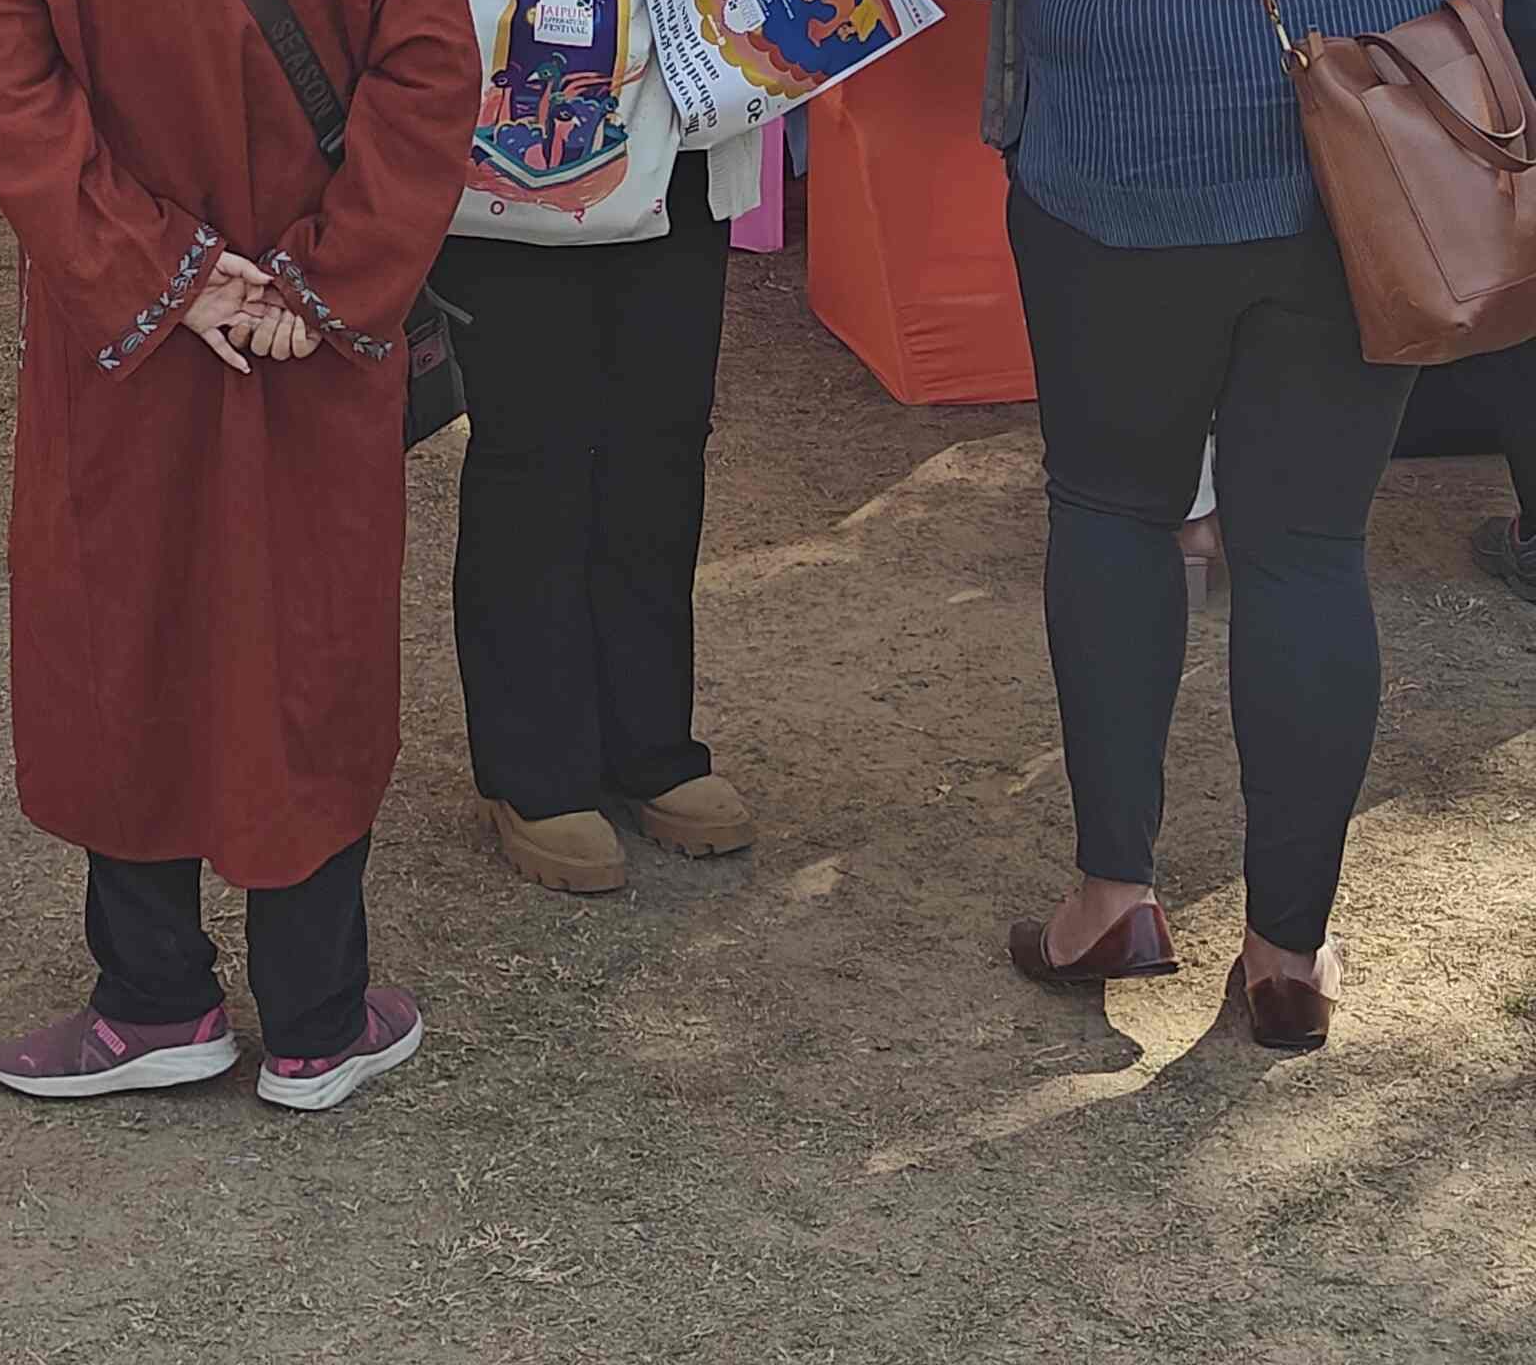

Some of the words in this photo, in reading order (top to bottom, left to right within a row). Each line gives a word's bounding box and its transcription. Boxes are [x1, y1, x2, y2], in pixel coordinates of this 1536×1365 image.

[695, 48, 720, 81] and
[675, 41, 718, 128] celebration
[92, 1019, 126, 1056] PUMA
